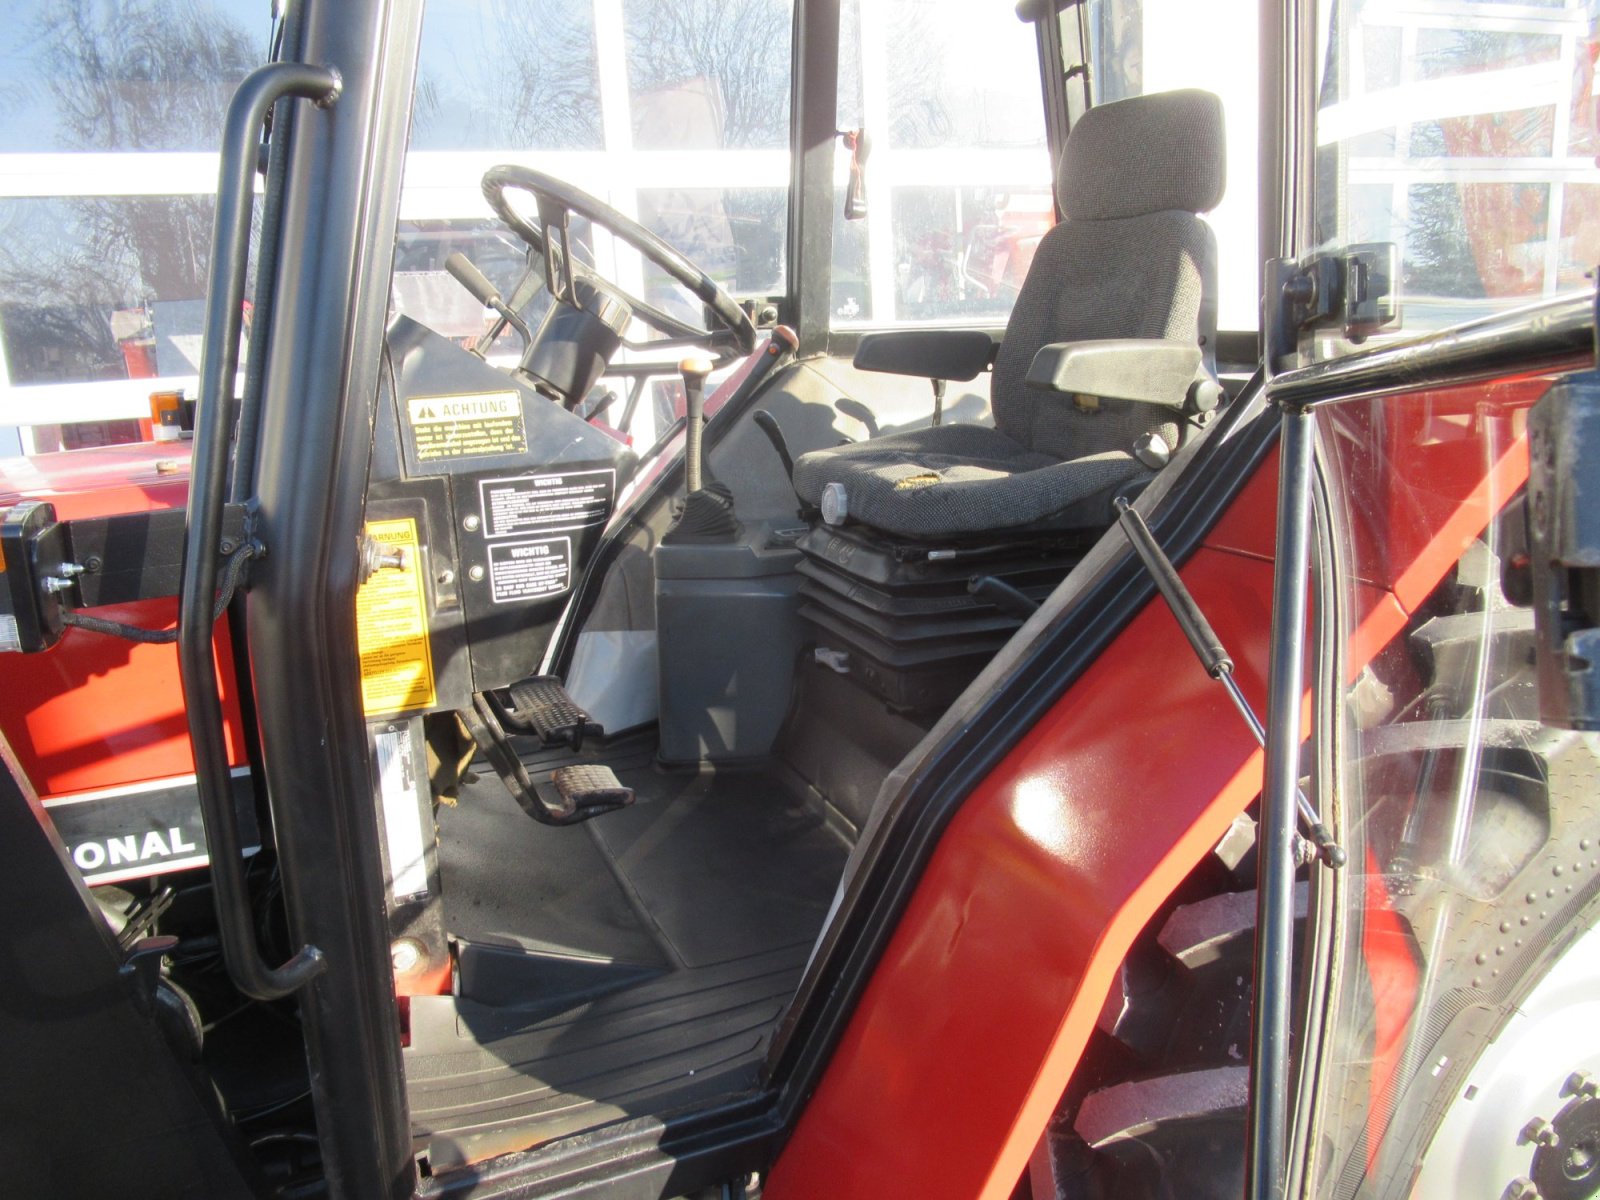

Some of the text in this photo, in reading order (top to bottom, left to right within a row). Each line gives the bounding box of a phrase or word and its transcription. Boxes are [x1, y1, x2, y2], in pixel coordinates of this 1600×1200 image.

[443, 400, 507, 417] ACHTUNG
[369, 531, 411, 542] ARNUNG
[511, 545, 550, 558] WICHTIG
[66, 827, 196, 870] ONAL
